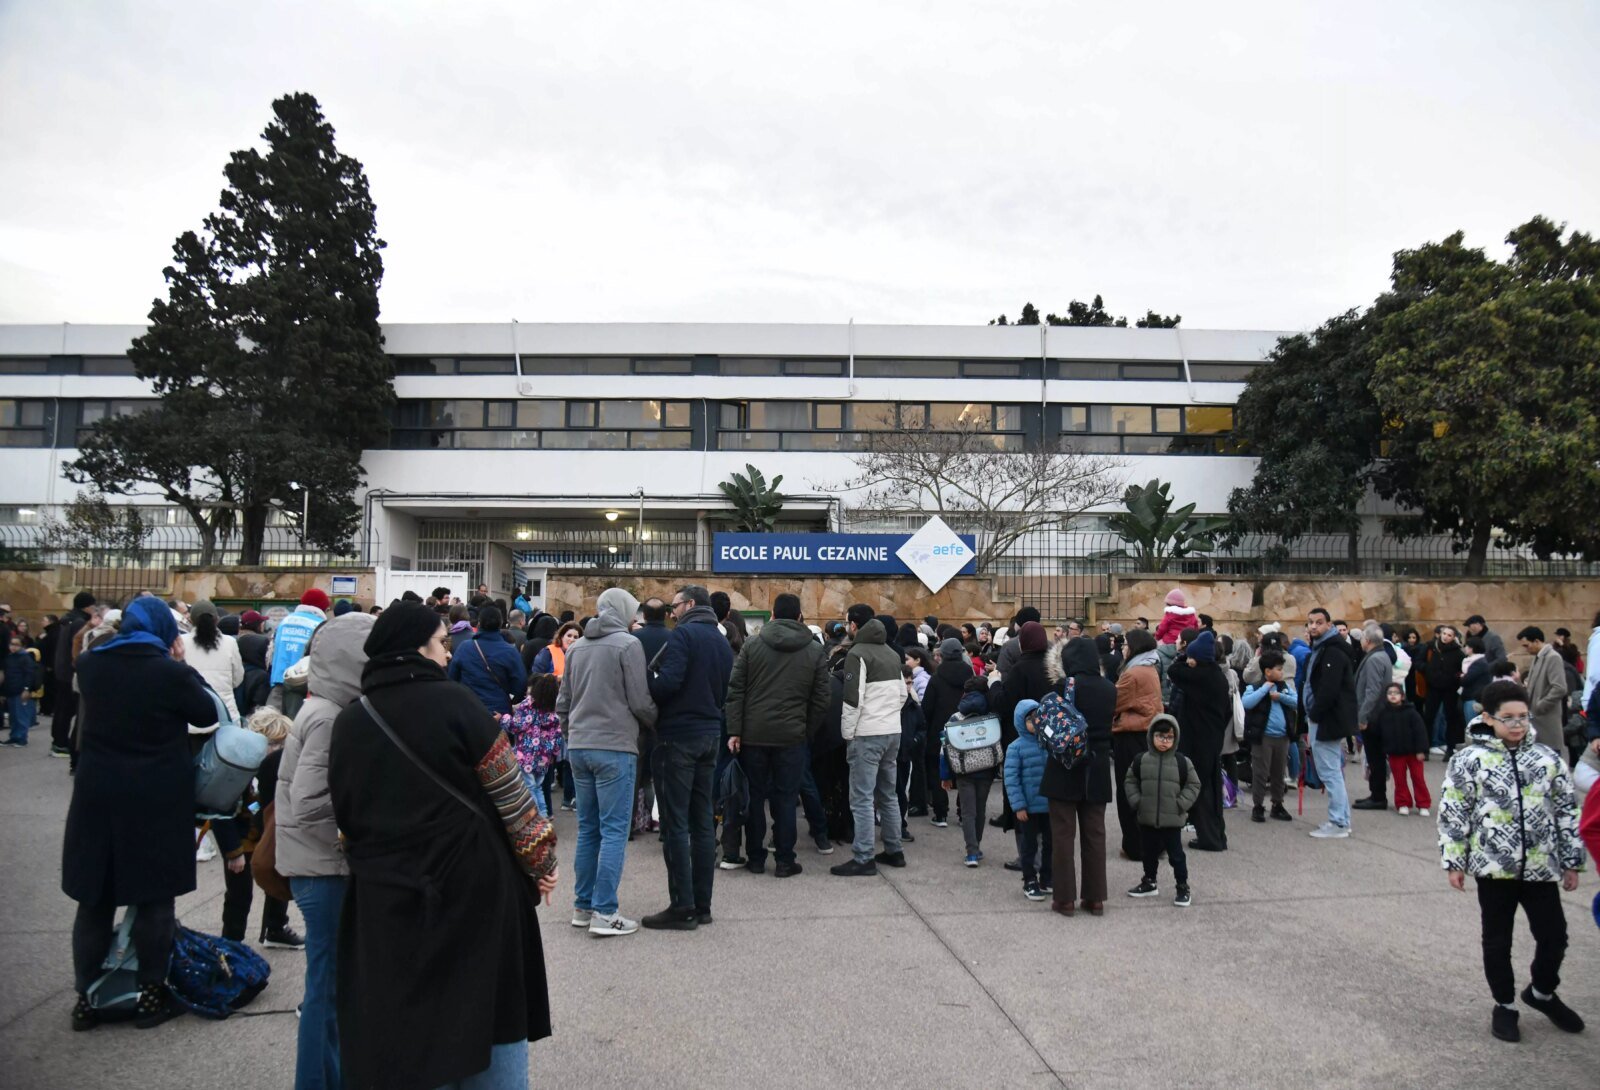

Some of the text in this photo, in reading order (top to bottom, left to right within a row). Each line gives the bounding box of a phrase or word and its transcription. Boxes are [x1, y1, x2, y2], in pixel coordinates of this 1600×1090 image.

[721, 545, 888, 561] ECOLE PAUL CEZANNE
[932, 543, 964, 555] aefe
